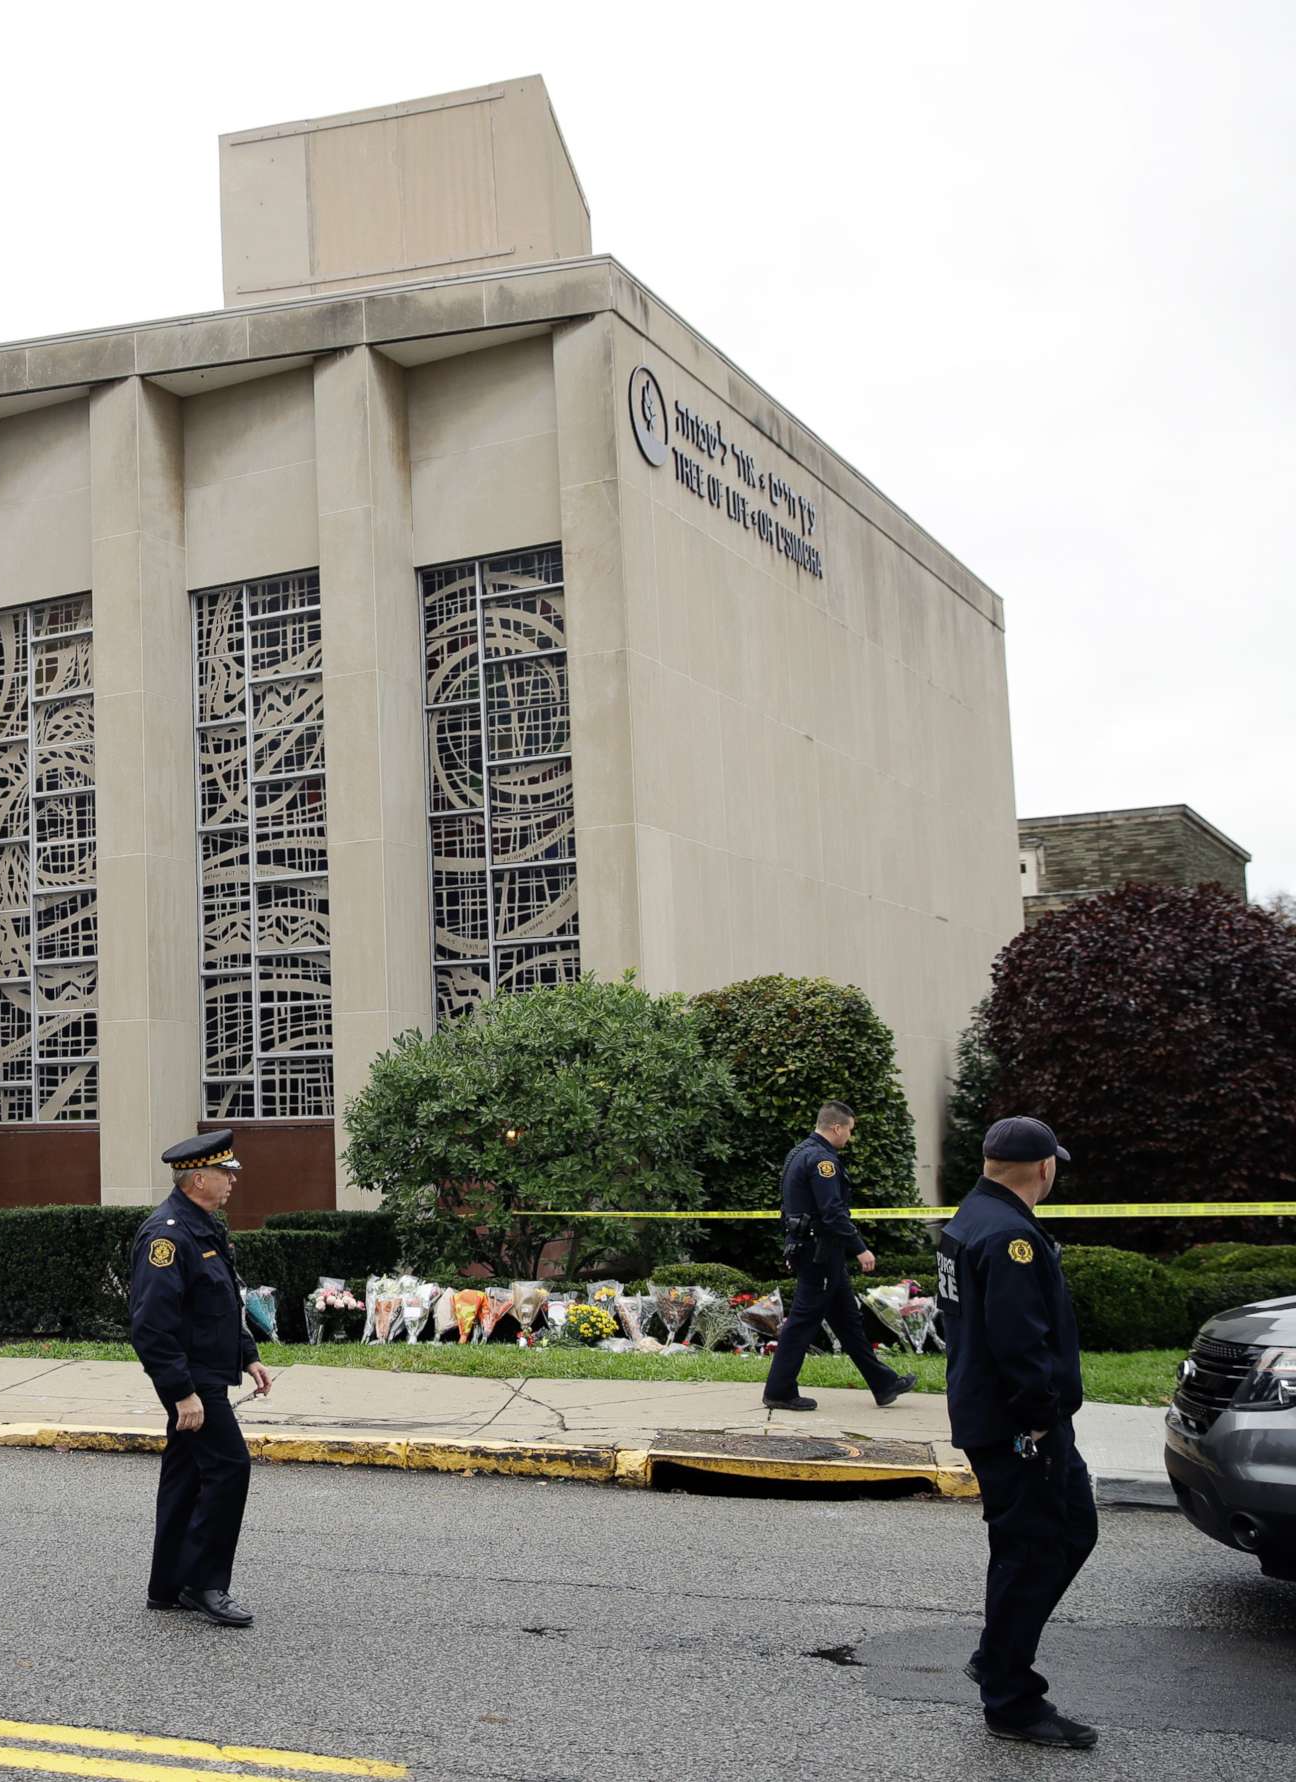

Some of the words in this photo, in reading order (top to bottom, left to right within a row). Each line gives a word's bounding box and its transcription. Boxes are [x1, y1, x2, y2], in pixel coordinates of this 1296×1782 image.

[672, 447, 705, 499] TREE
[707, 474, 723, 509] OF
[726, 486, 750, 530] LIFE
[757, 509, 774, 546] OR
